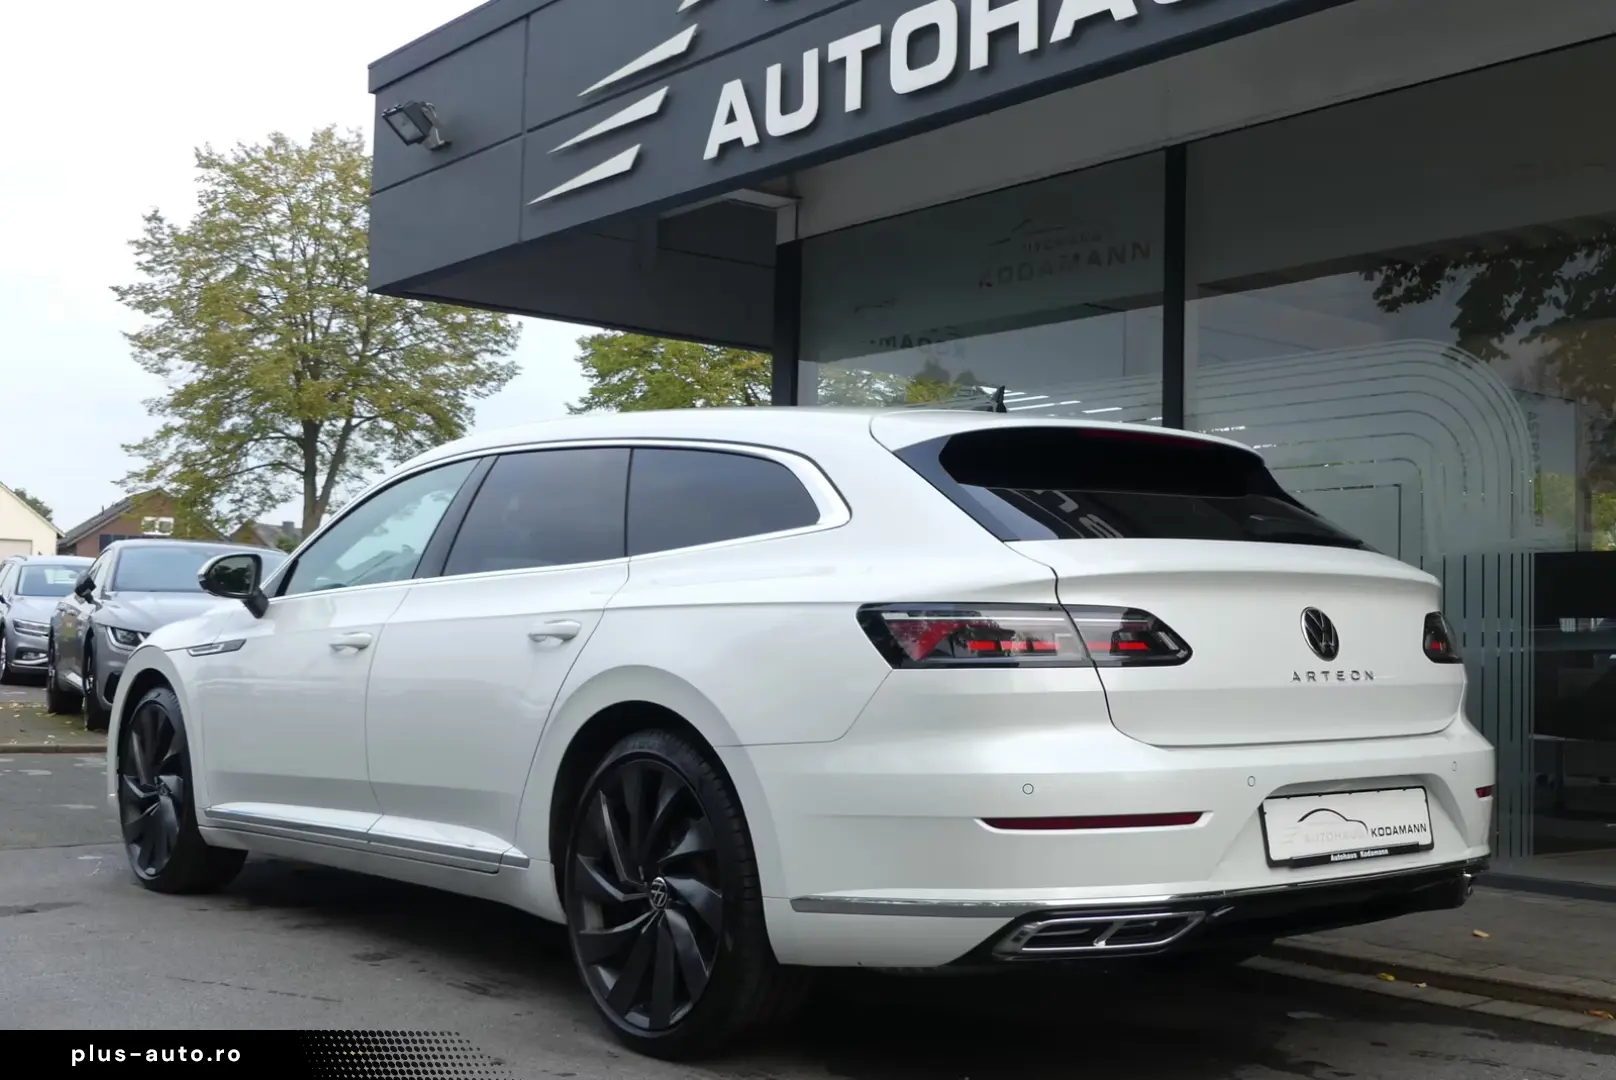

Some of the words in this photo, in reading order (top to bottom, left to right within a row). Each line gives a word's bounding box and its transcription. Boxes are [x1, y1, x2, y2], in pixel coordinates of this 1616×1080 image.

[1291, 670, 1375, 682] ARTEON
[1370, 823, 1427, 838] KODAMANN
[1331, 852, 1357, 862] Autohaus
[1360, 849, 1388, 858] Kodamann
